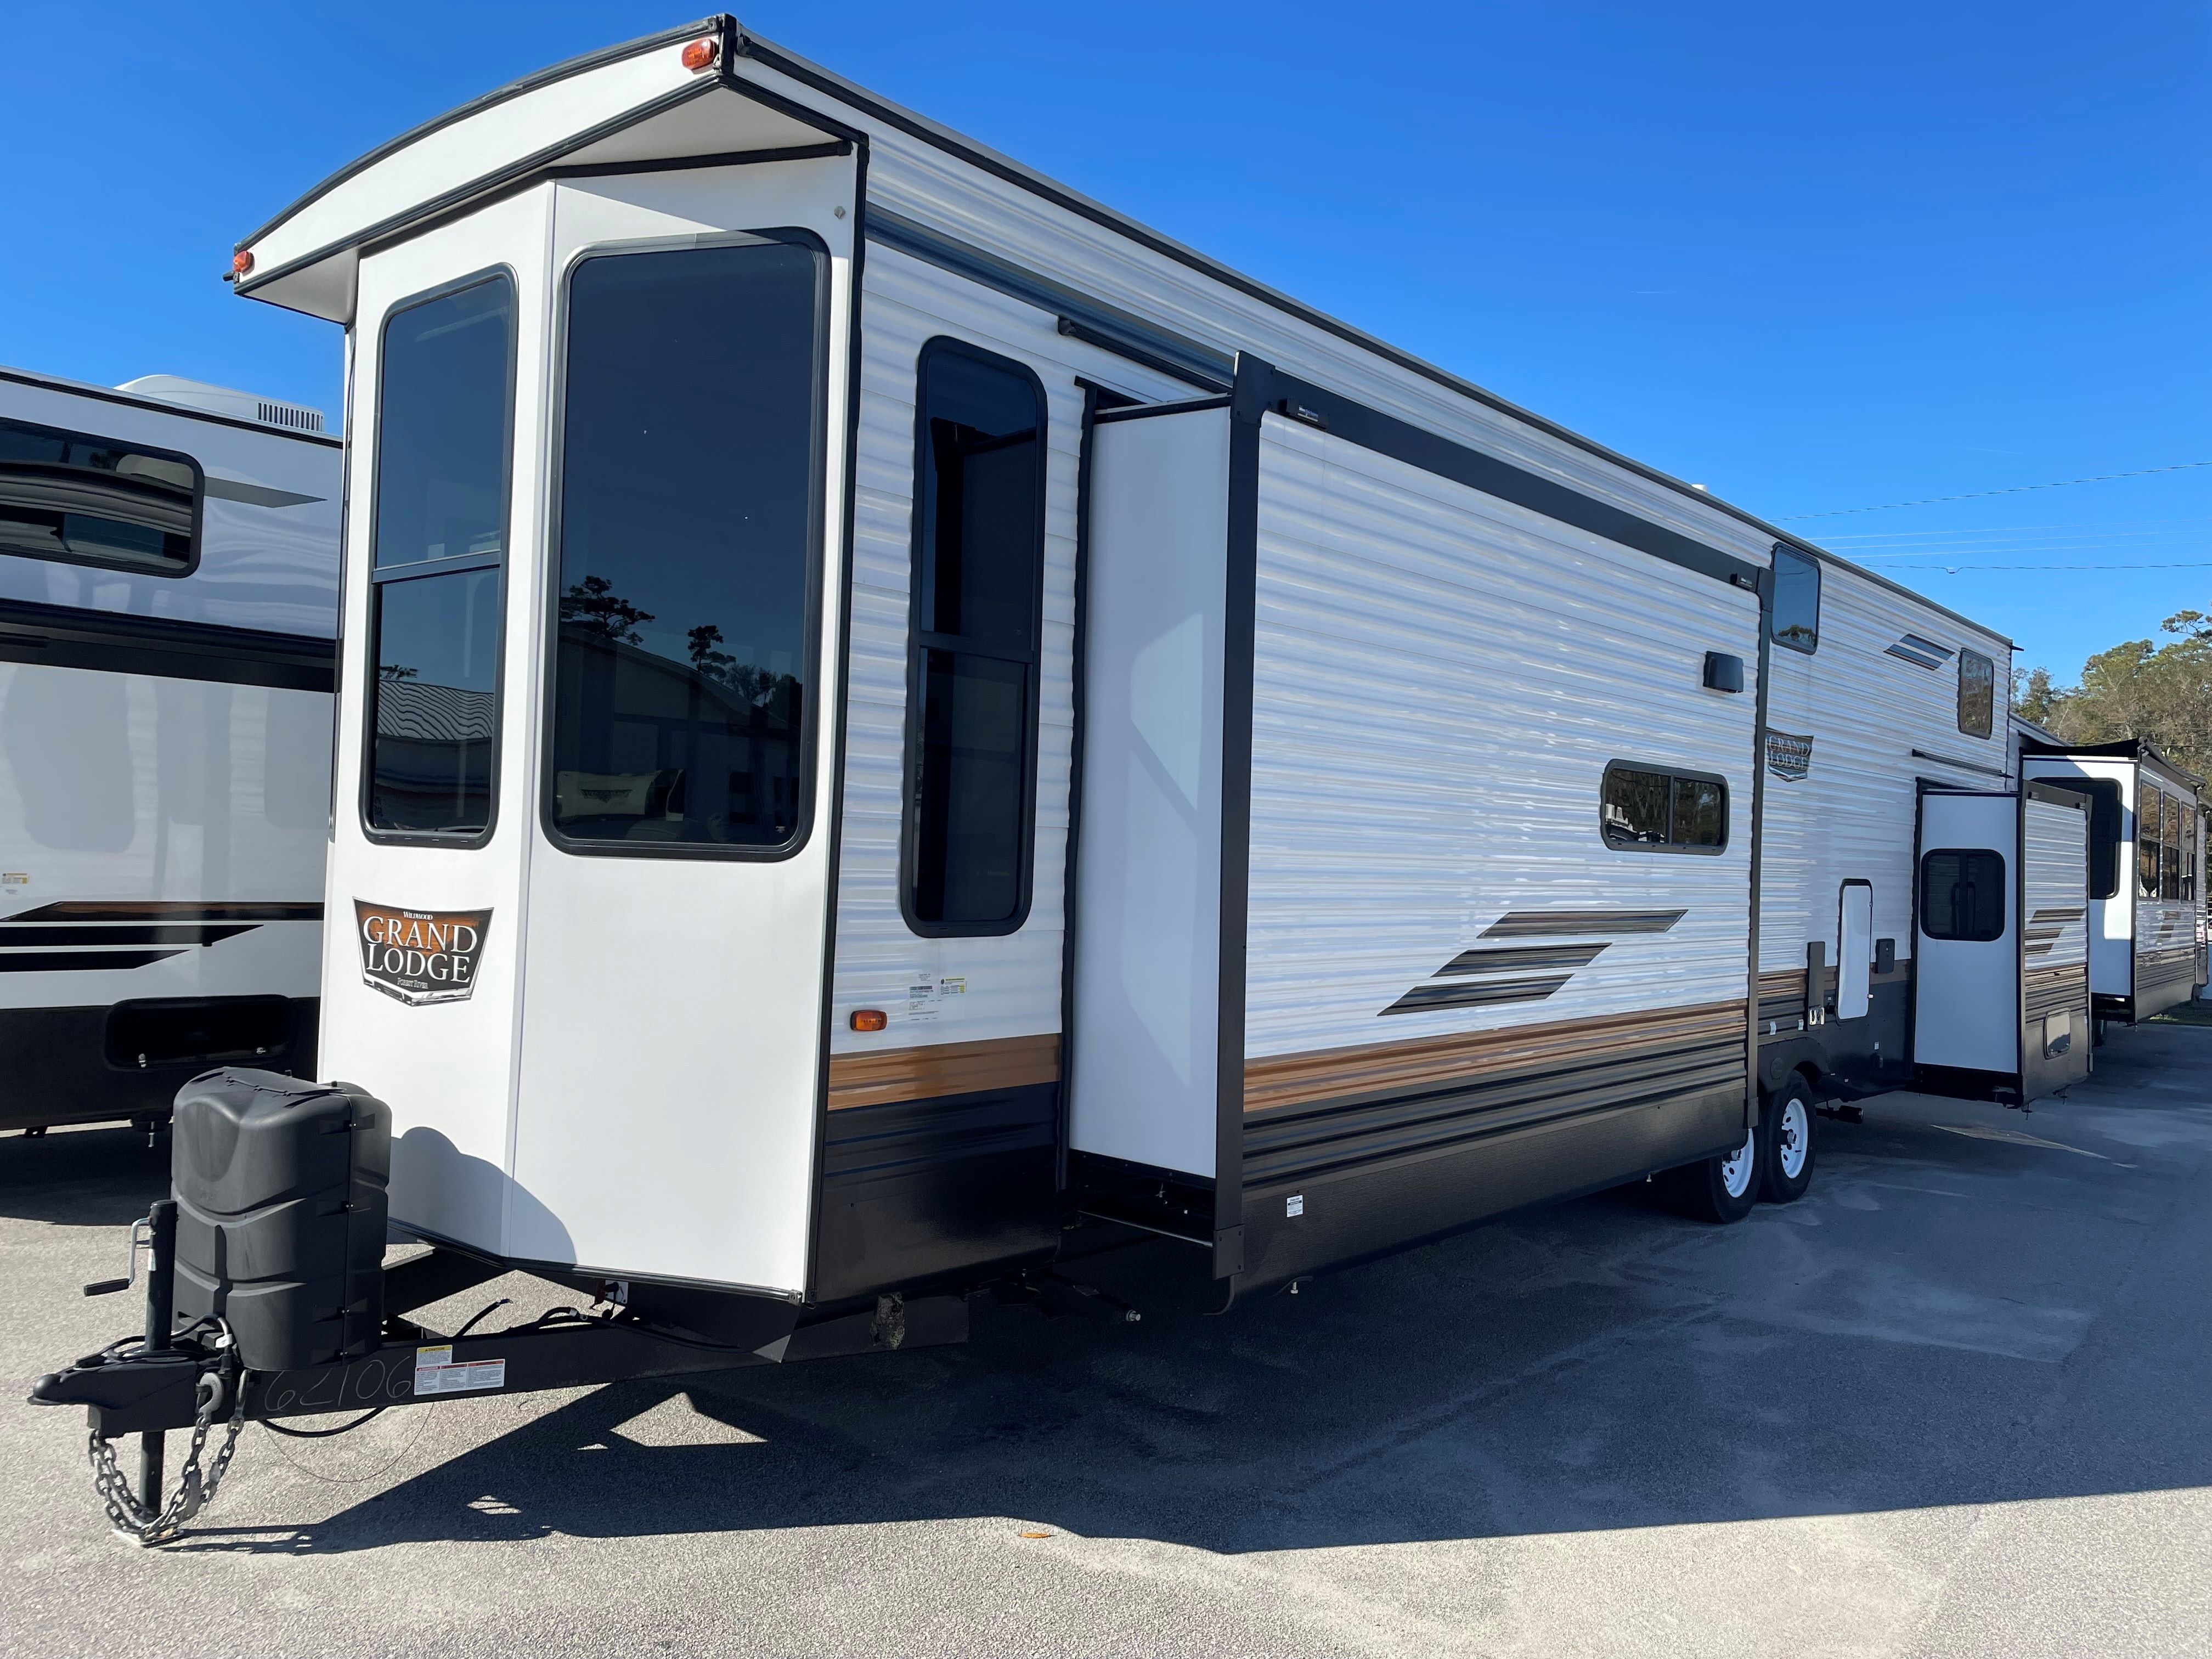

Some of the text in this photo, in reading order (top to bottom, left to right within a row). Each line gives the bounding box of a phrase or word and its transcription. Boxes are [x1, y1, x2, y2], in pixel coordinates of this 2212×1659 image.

[1769, 736, 1810, 755] GRAND
[1769, 751, 1808, 769] LODGE
[403, 911, 433, 921] WILDWOOD
[363, 916, 477, 953] GRAND
[366, 943, 470, 983] LODGE
